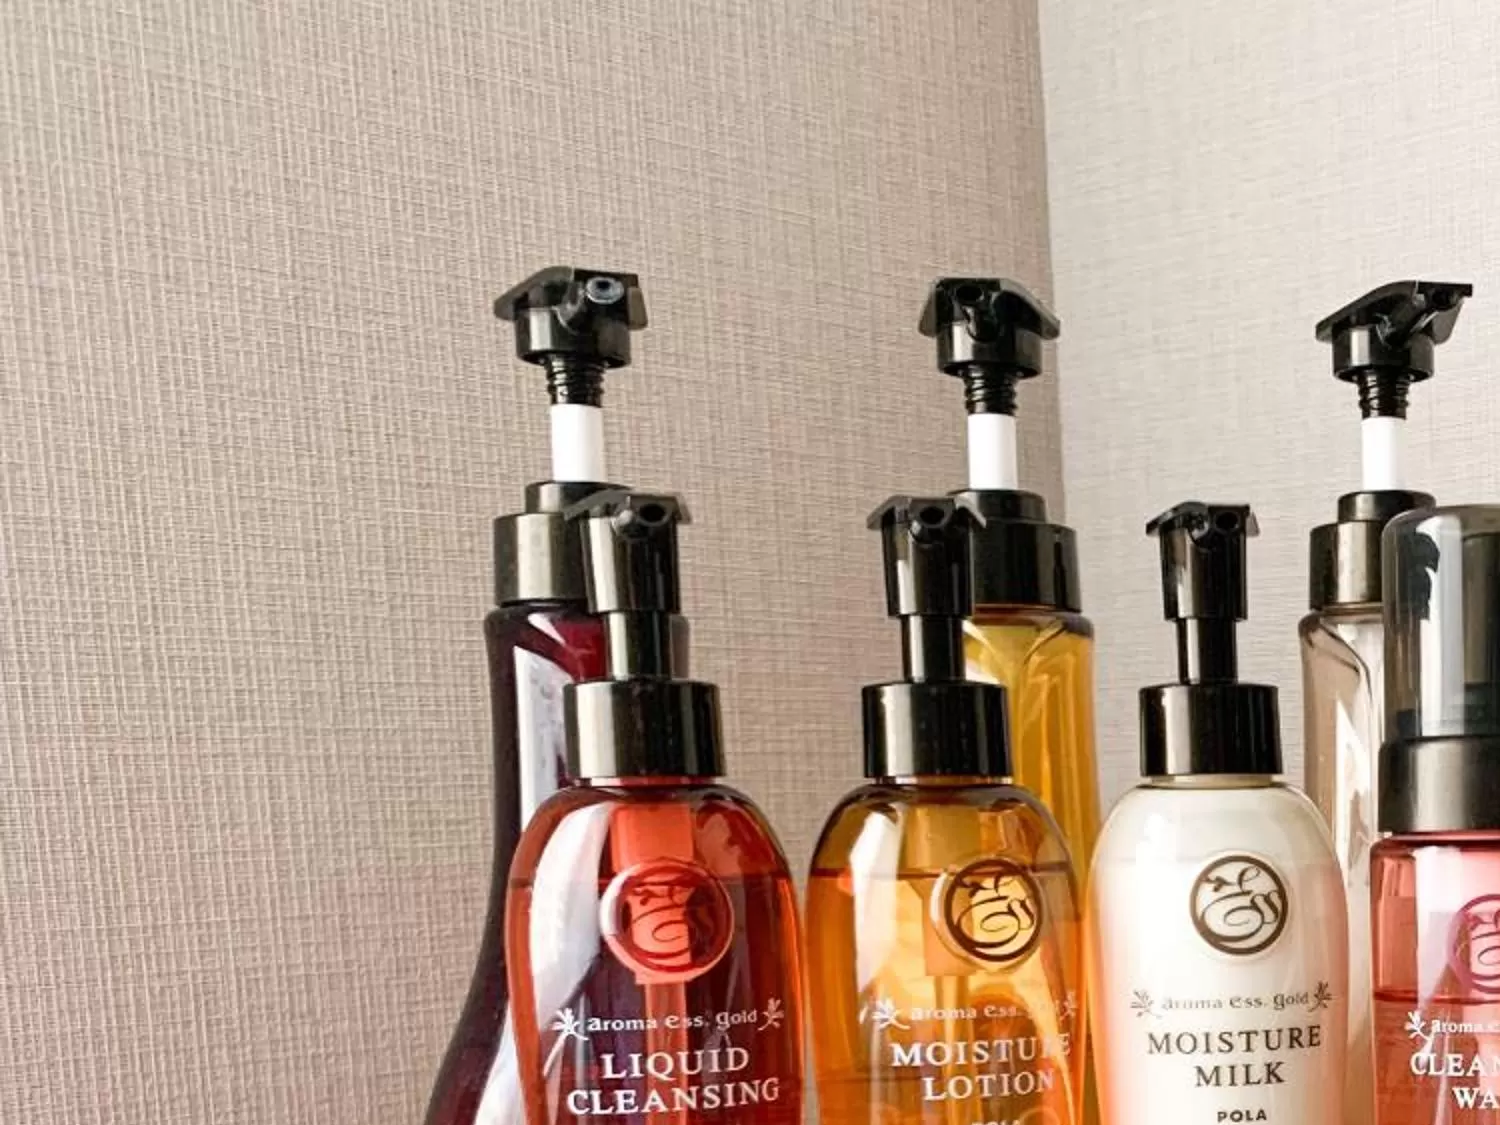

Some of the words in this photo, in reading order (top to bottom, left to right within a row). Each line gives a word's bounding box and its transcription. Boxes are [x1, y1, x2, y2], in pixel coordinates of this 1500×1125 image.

[1162, 997, 1222, 1010] aroma
[1273, 992, 1309, 1011] gold
[587, 1014, 658, 1031] aroma
[715, 1008, 758, 1028] gold
[1147, 1024, 1322, 1055] MOISTURE
[599, 1046, 750, 1081] LIQUID
[1194, 1061, 1286, 1088] MILK
[566, 1077, 780, 1116] CLEANSING
[922, 1067, 1056, 1101] LOTION
[1217, 1109, 1268, 1123] POLA
